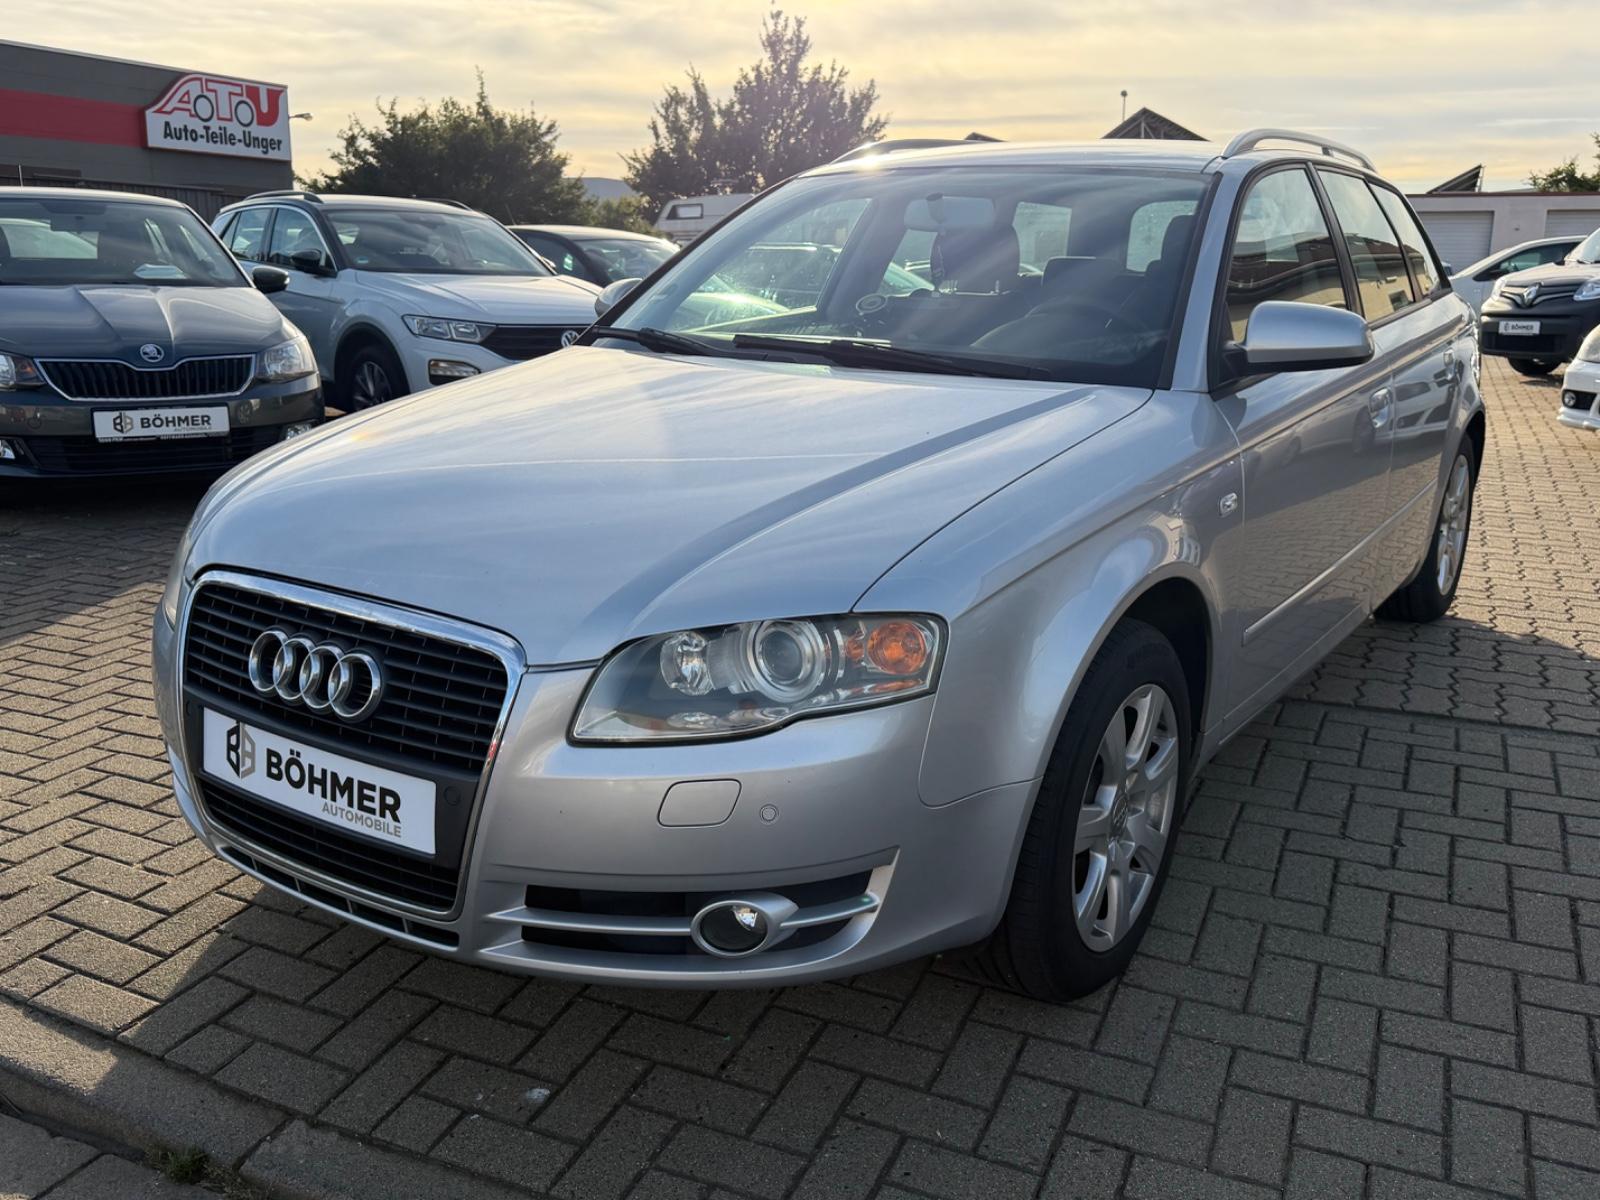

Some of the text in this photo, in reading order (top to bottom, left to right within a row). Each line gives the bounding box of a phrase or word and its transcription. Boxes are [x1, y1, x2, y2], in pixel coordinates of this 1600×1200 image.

[164, 121, 282, 154] Auto-Teile-Unger
[140, 414, 212, 429] BÖHMER
[266, 748, 402, 823] BÖHMER
[322, 802, 402, 838] AUTOMOBILE
